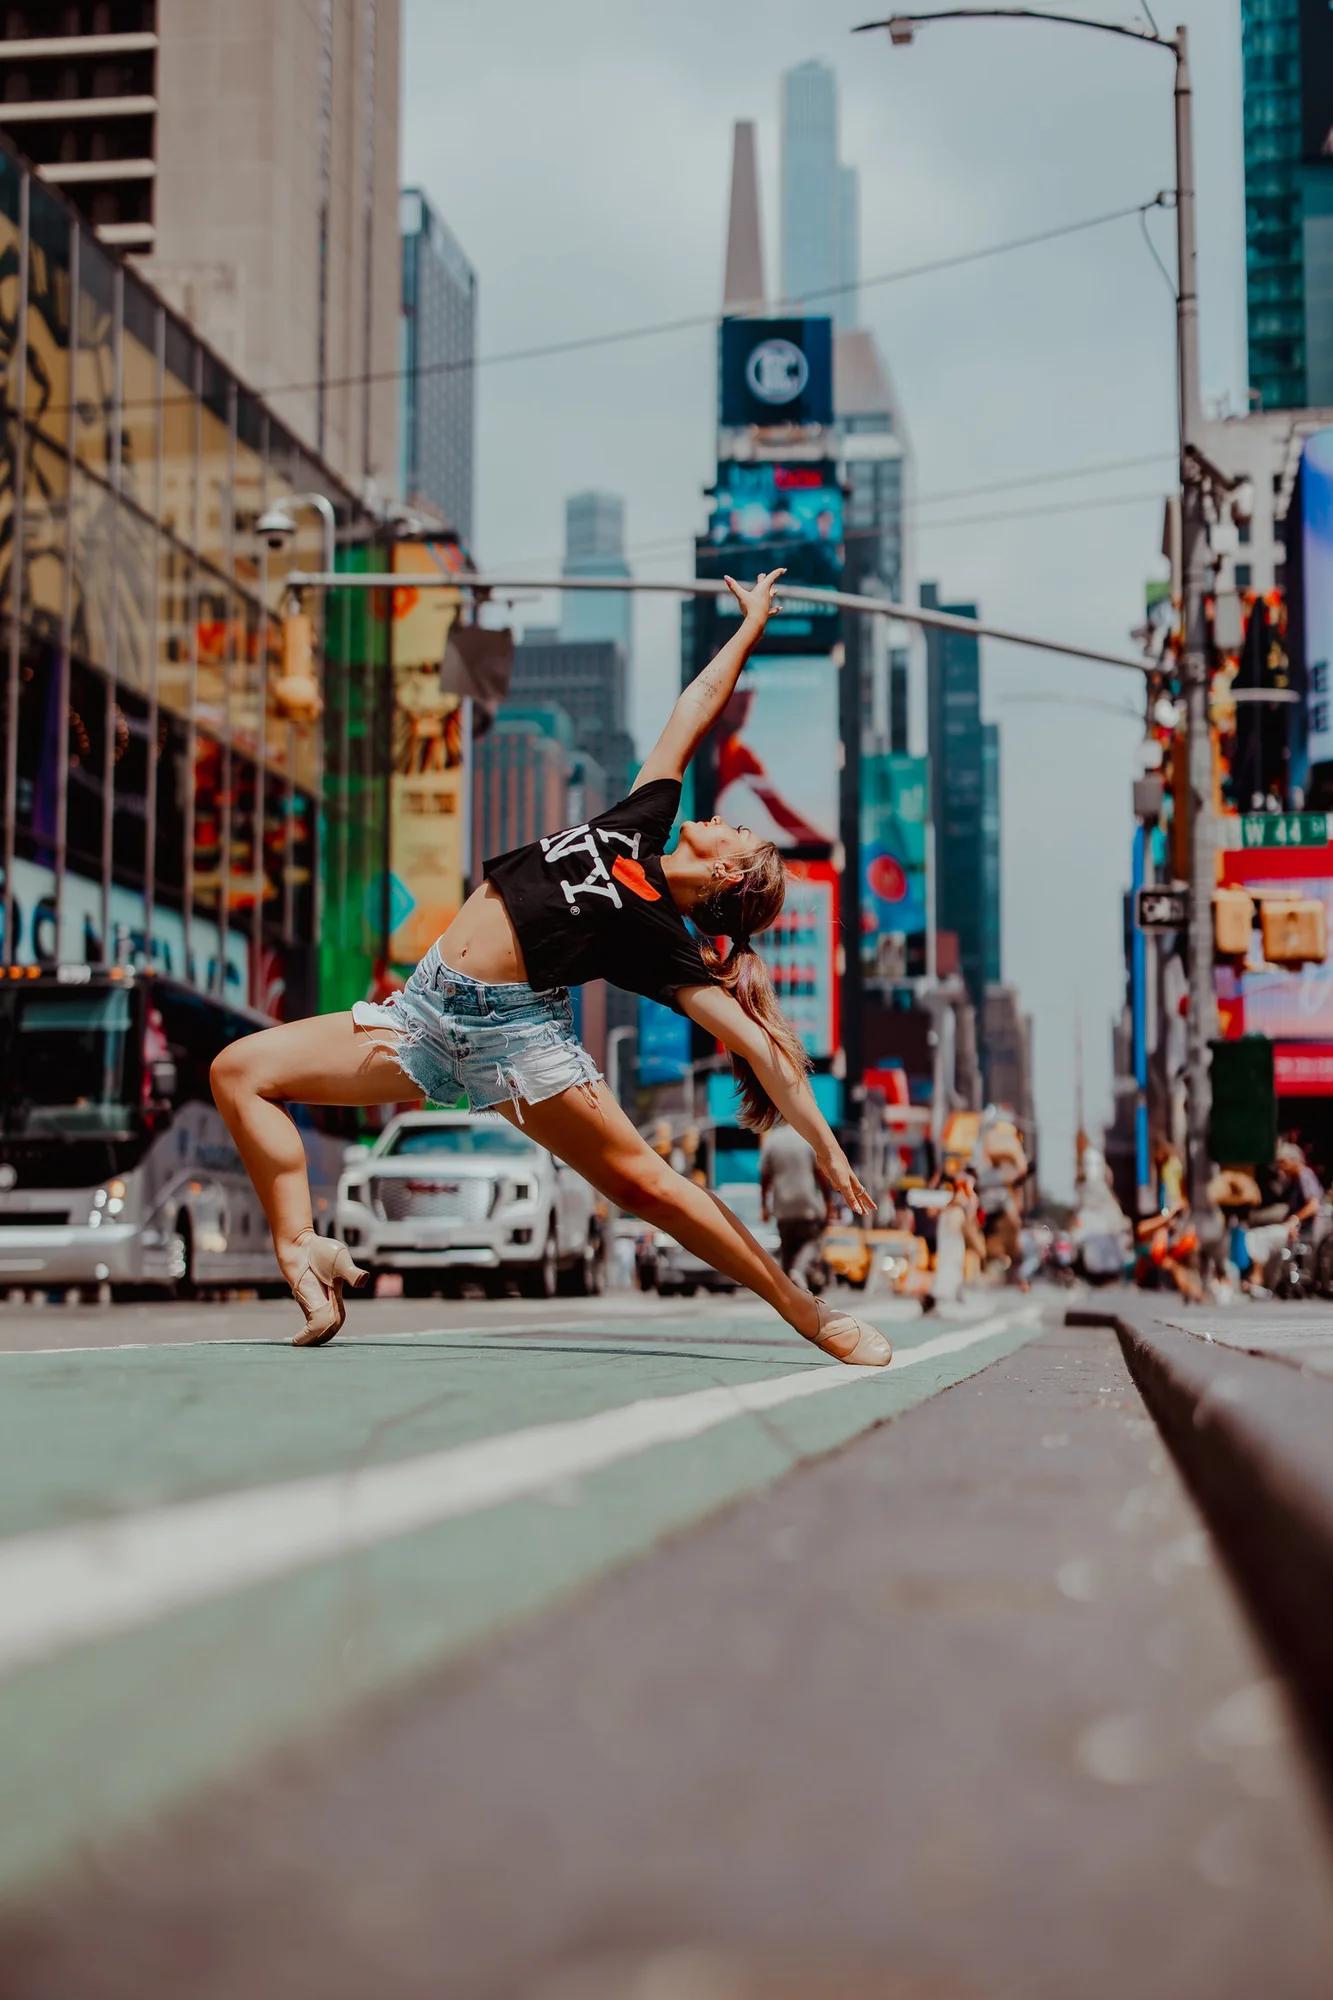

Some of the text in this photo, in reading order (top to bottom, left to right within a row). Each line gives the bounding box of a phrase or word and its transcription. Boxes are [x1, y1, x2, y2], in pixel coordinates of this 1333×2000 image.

[1244, 817, 1265, 846] W
[1274, 816, 1301, 844] 44
[539, 823, 623, 909] NY
